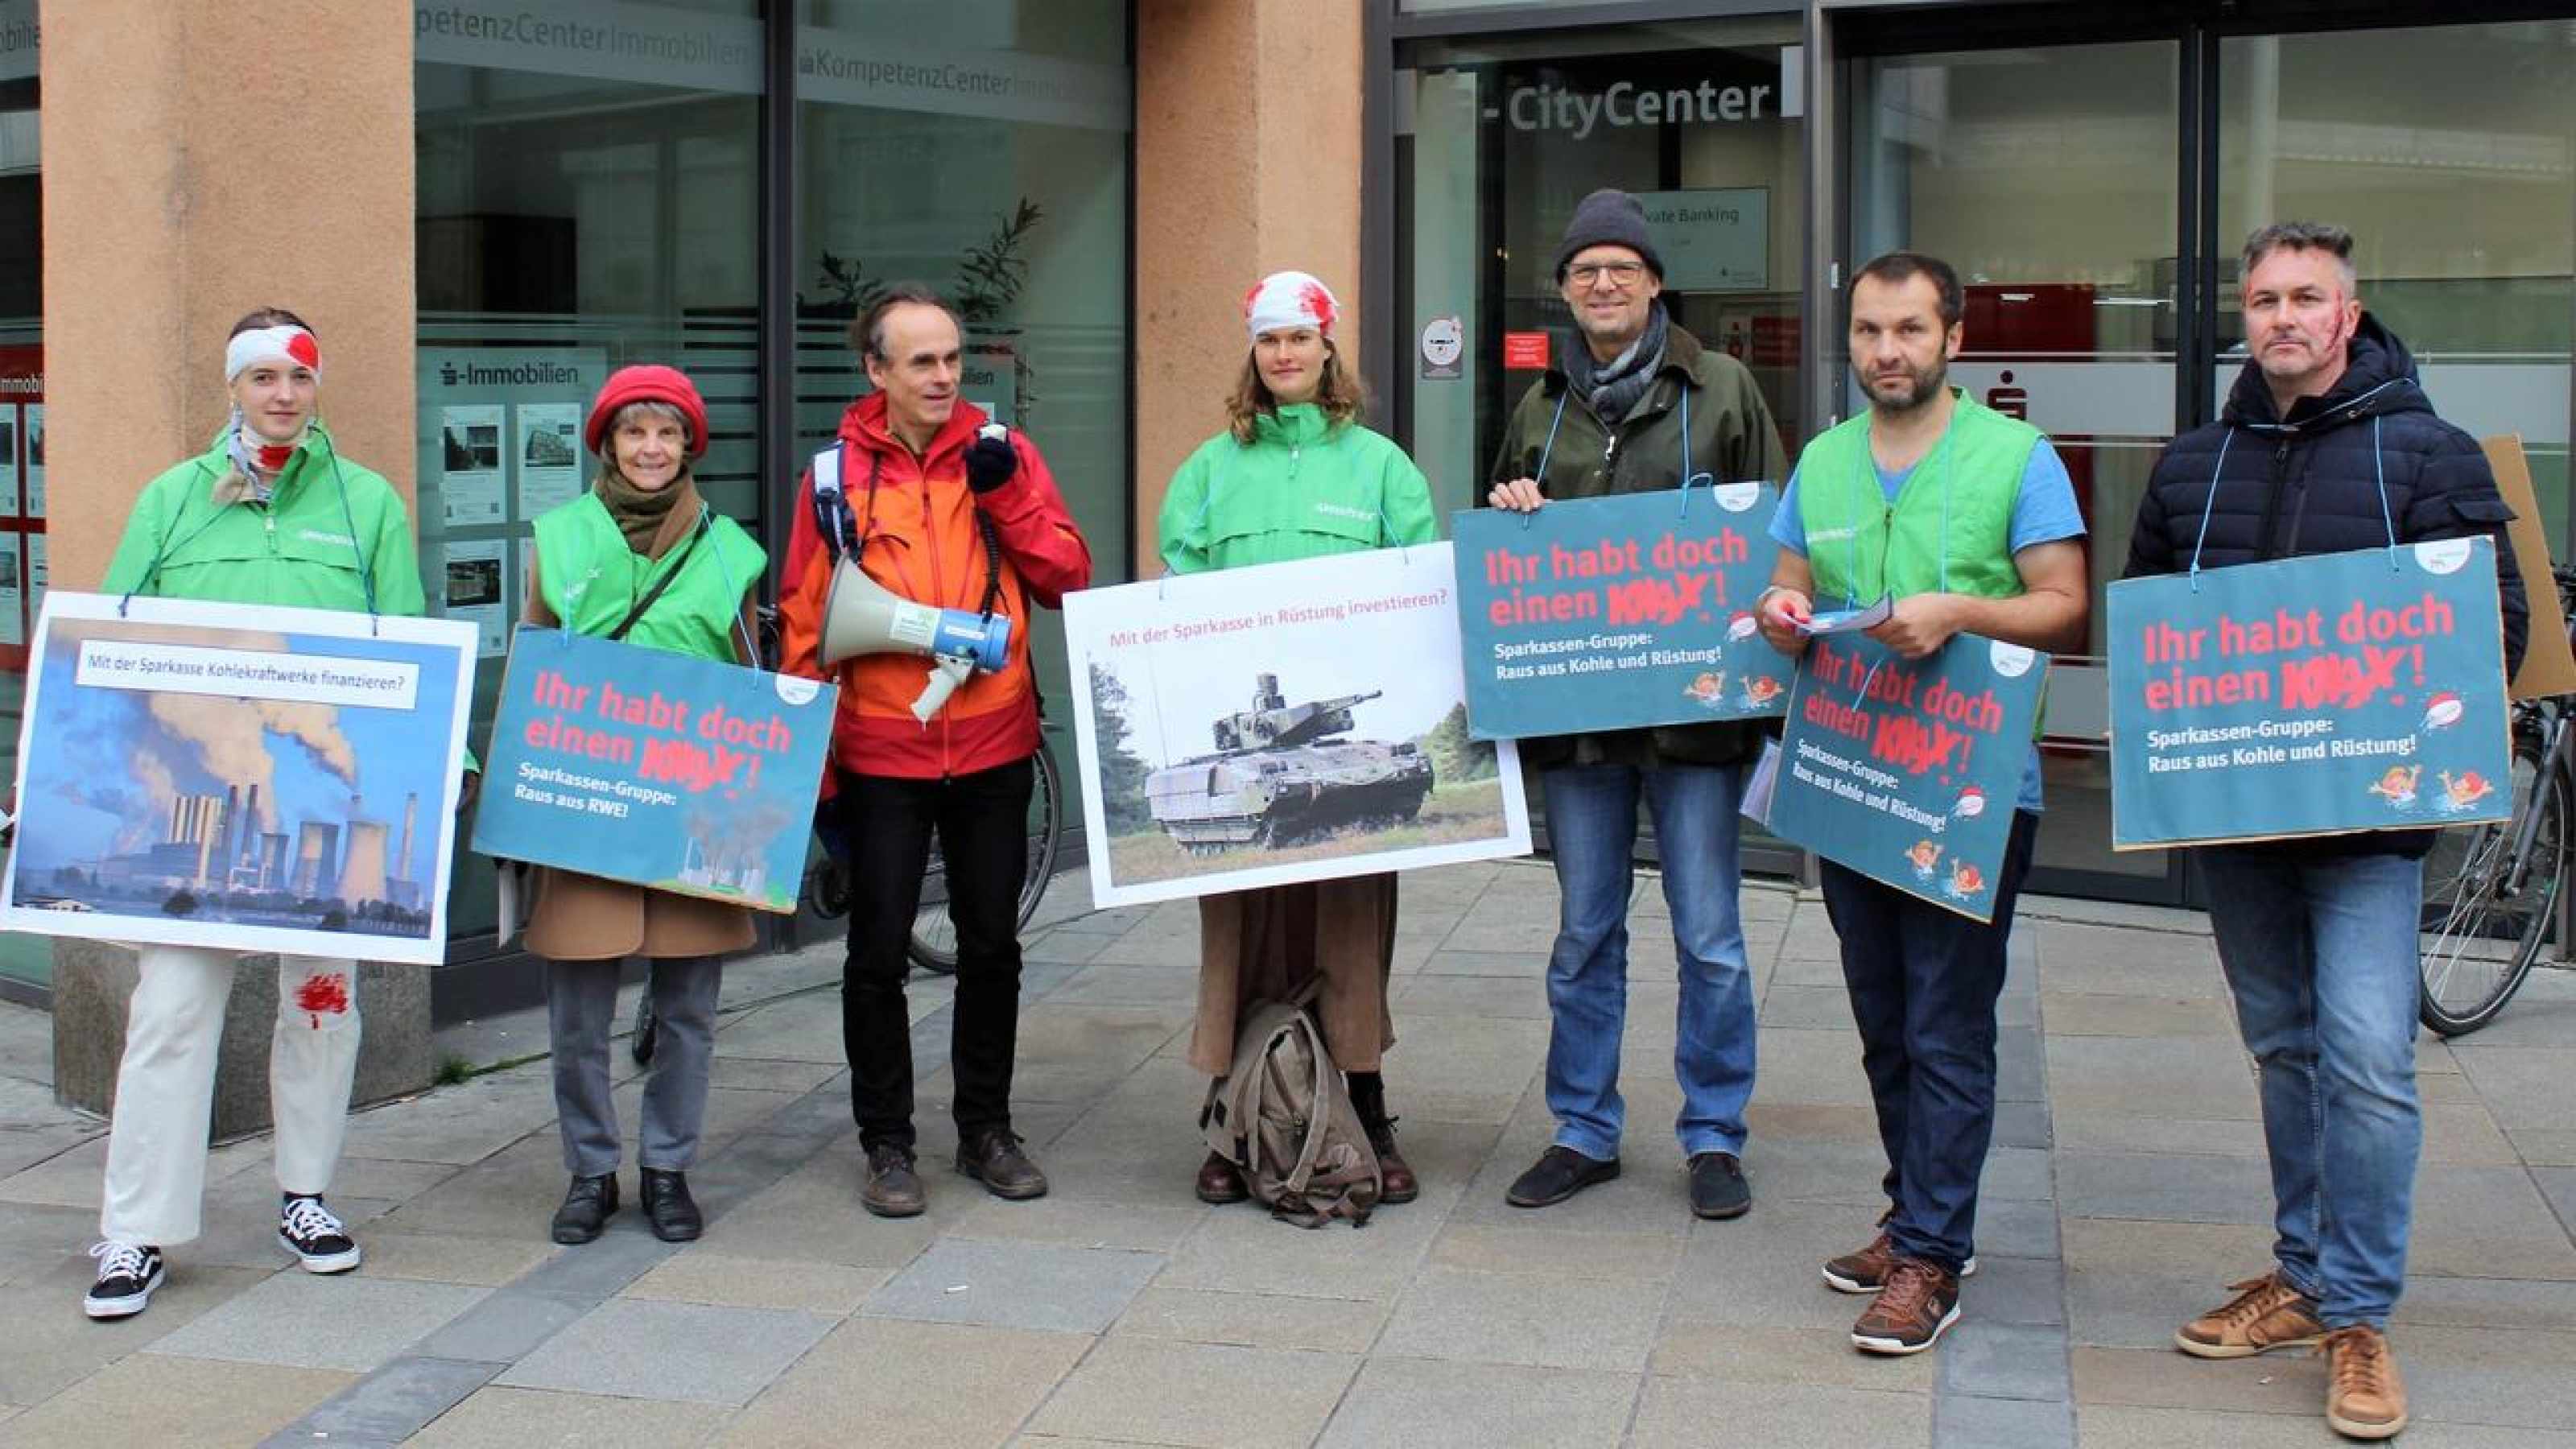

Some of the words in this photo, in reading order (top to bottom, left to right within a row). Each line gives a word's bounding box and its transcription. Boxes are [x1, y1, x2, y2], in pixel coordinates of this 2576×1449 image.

[415, 7, 604, 51] petenzCenter
[1679, 204, 1740, 225] Banking
[1485, 547, 1541, 586] Ihr
[1550, 538, 1641, 580] habt
[1652, 526, 1748, 572] doch
[1111, 630, 1139, 647] Mit
[1142, 628, 1168, 643] der
[1173, 617, 1255, 640] Sparkasse
[1259, 611, 1274, 627] in
[1348, 588, 1447, 614] investieren?
[1488, 587, 1598, 627] einen
[2143, 621, 2207, 665] Ihr
[2219, 608, 2325, 657] habt
[2337, 592, 2454, 645] doch
[1495, 633, 1652, 660] Sparkassen-Gruppe:
[1496, 664, 1534, 679] Raus
[1538, 663, 1567, 676] aus
[1569, 655, 1613, 675] Kohle
[1616, 652, 1647, 669] und
[1651, 646, 1722, 665] Rüstung!
[89, 654, 111, 669] Mit
[140, 656, 204, 675] Sparkasse
[207, 660, 318, 684] Kohlekraftwerke
[1813, 642, 1846, 684] Ihr
[1848, 650, 1918, 708] habt
[1923, 676, 2004, 734] doch
[2145, 667, 2271, 711] einen
[534, 669, 592, 712] Ihr
[598, 679, 689, 733] habt
[698, 702, 792, 753] doch
[1803, 688, 1871, 741] einen
[526, 713, 635, 764] einen
[2147, 719, 2334, 749] Sparkassen-Gruppe:
[2149, 755, 2190, 773] Raus
[2195, 753, 2229, 770] aus
[2233, 746, 2287, 765] Kohle
[2290, 740, 2326, 759] und
[2331, 733, 2416, 757] Rüstung!
[515, 783, 555, 803] Raus
[556, 794, 584, 810] aus
[588, 798, 629, 818] RWE!
[1832, 777, 1864, 803] Kohle
[1865, 793, 1889, 812] und
[1890, 797, 1946, 834] Rüstung!
